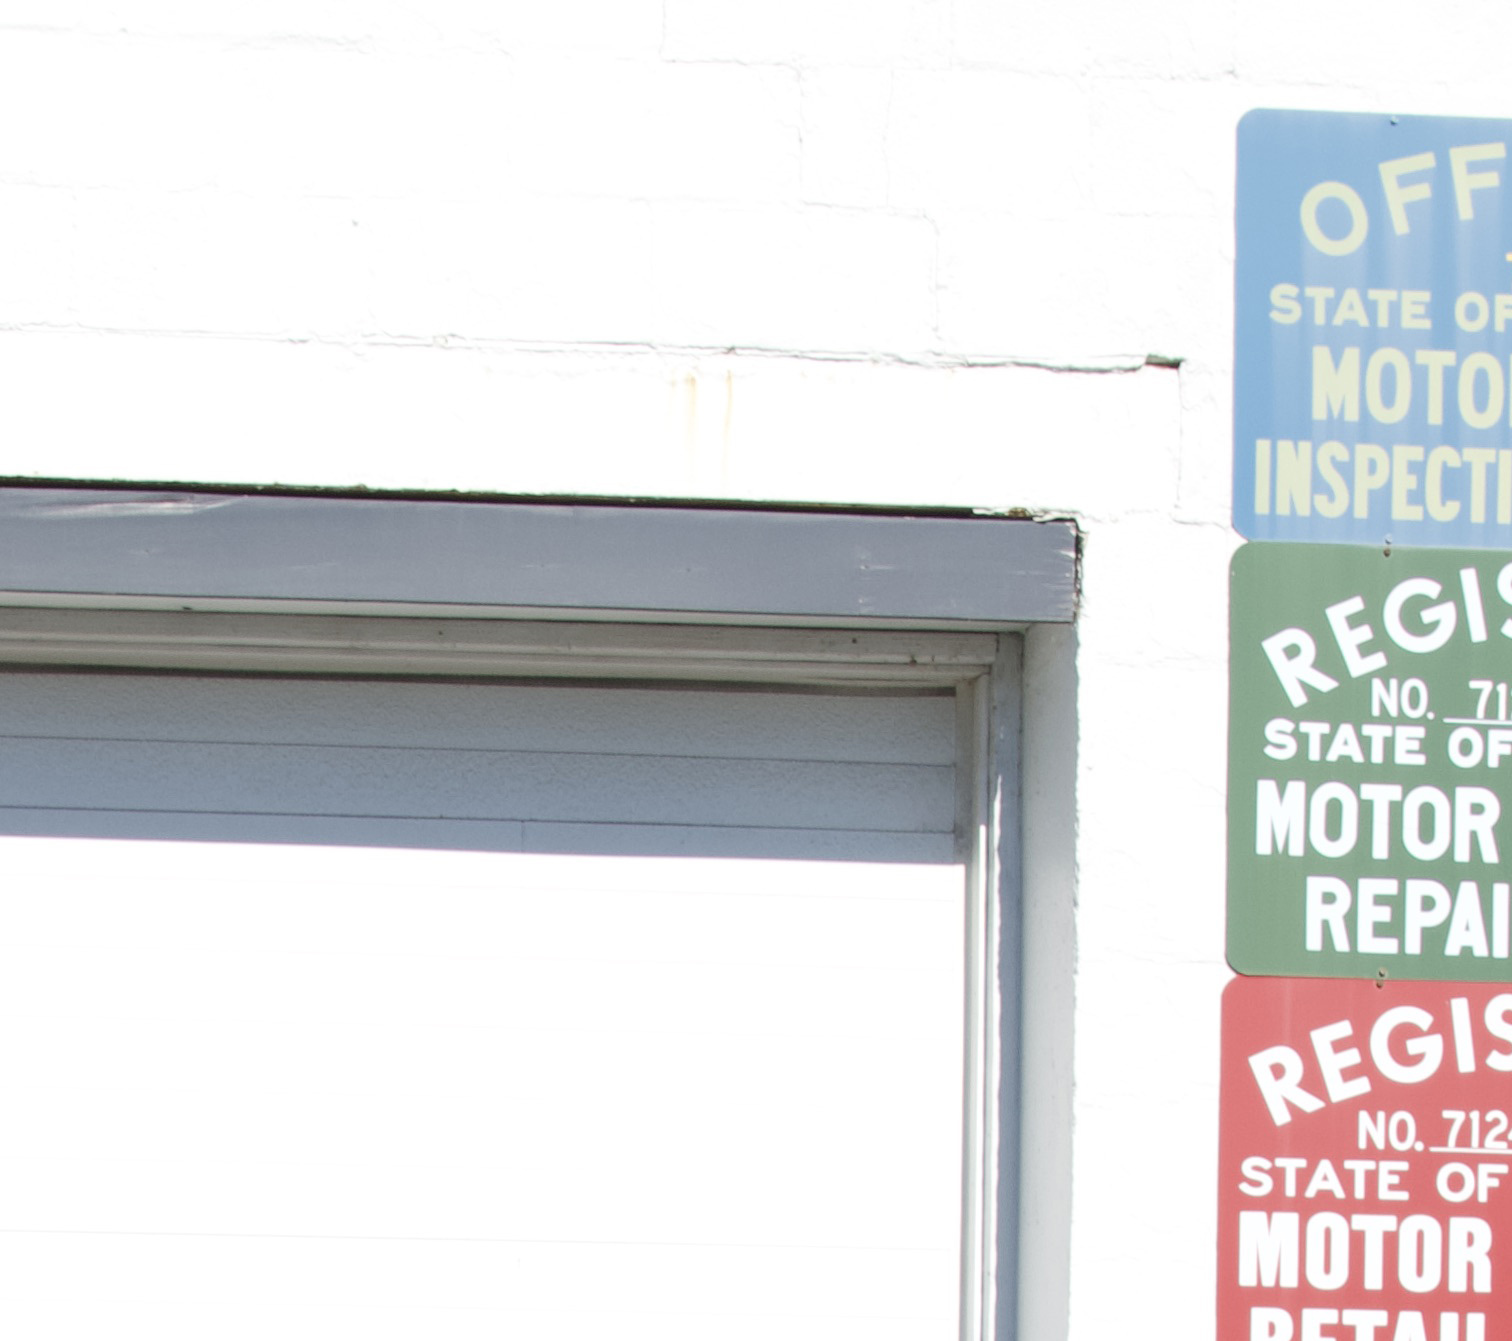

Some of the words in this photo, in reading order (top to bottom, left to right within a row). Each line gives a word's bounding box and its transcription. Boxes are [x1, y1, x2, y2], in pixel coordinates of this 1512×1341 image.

[1269, 283, 1432, 329] STATE
[1371, 678, 1435, 720] NO.
[1263, 718, 1426, 765] STATE
[1255, 779, 1500, 864] MOTOR
[1357, 1110, 1424, 1152] NO.
[1238, 1156, 1410, 1201] STATE
[1436, 1161, 1509, 1203] OF
[1238, 1210, 1493, 1294] MOTOR
